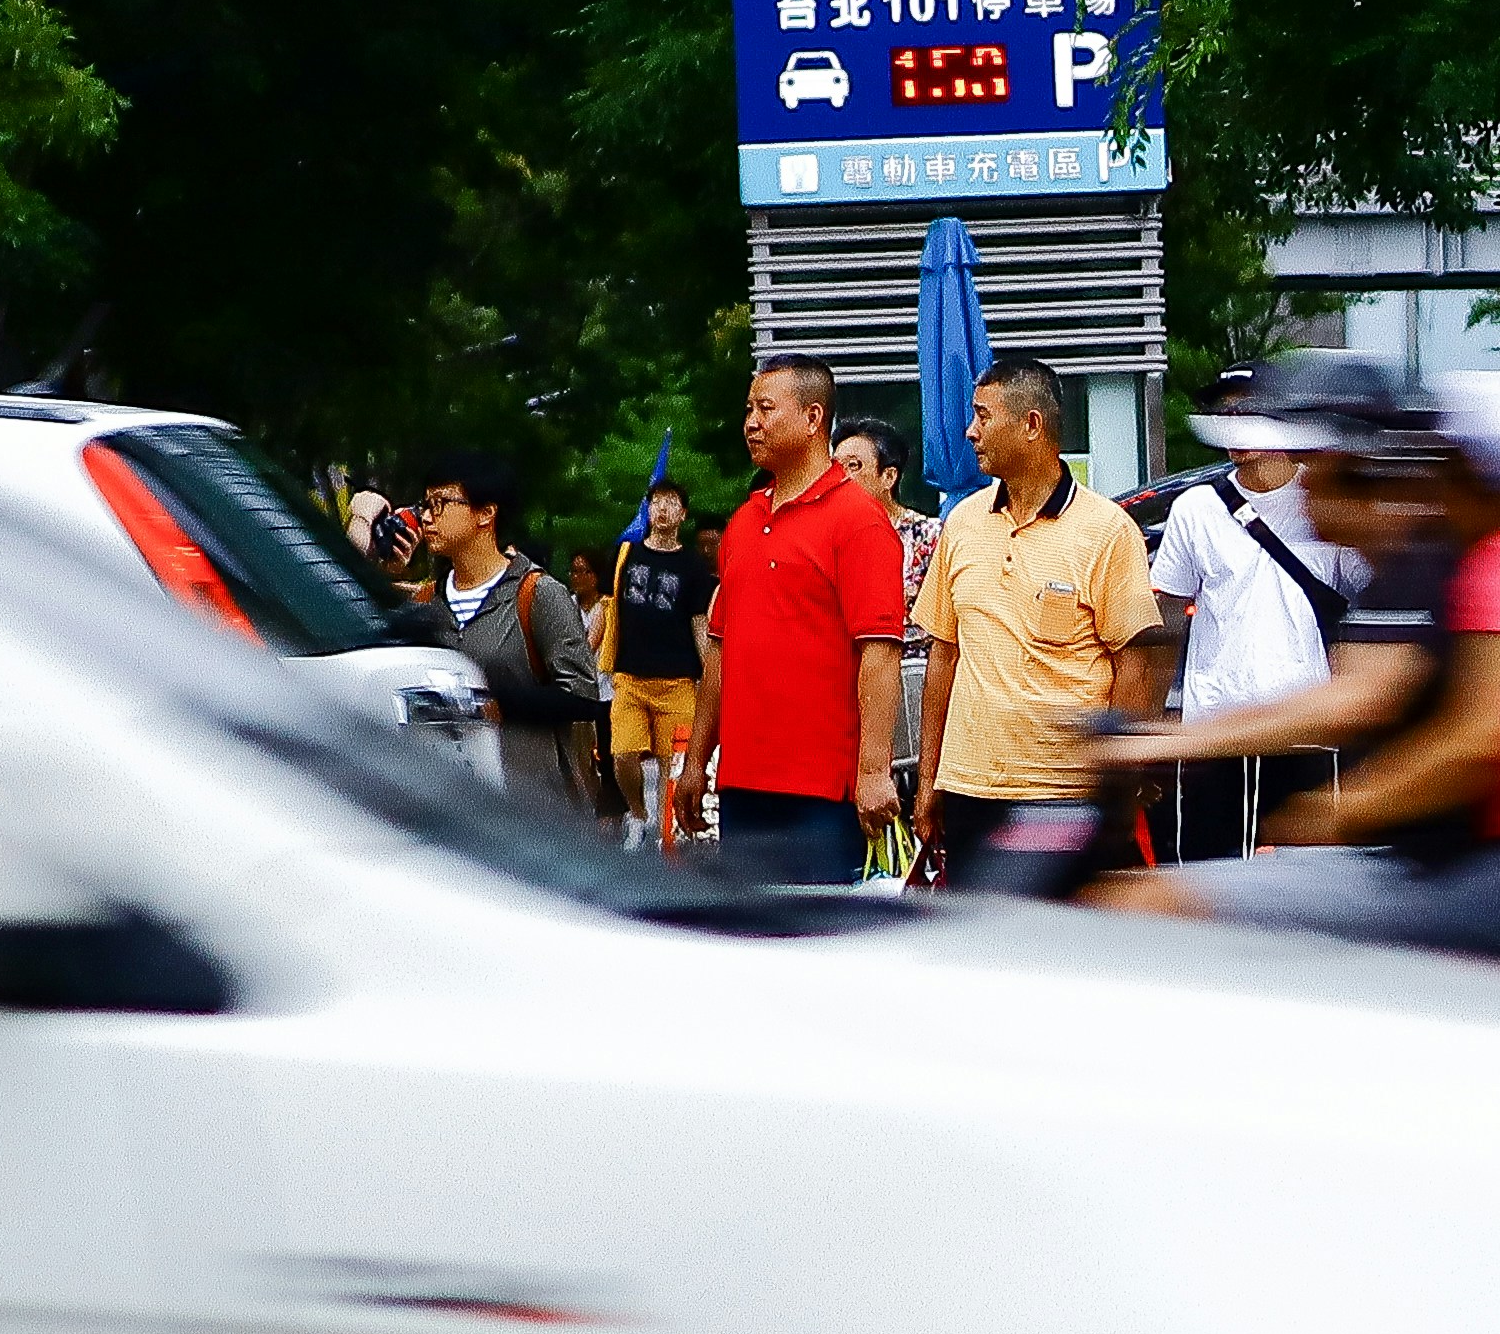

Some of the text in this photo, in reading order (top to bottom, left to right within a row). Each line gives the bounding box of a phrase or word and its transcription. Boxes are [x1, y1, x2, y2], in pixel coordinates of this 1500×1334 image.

[1053, 31, 1113, 108] P
[841, 146, 1082, 189] 電動車充電區
